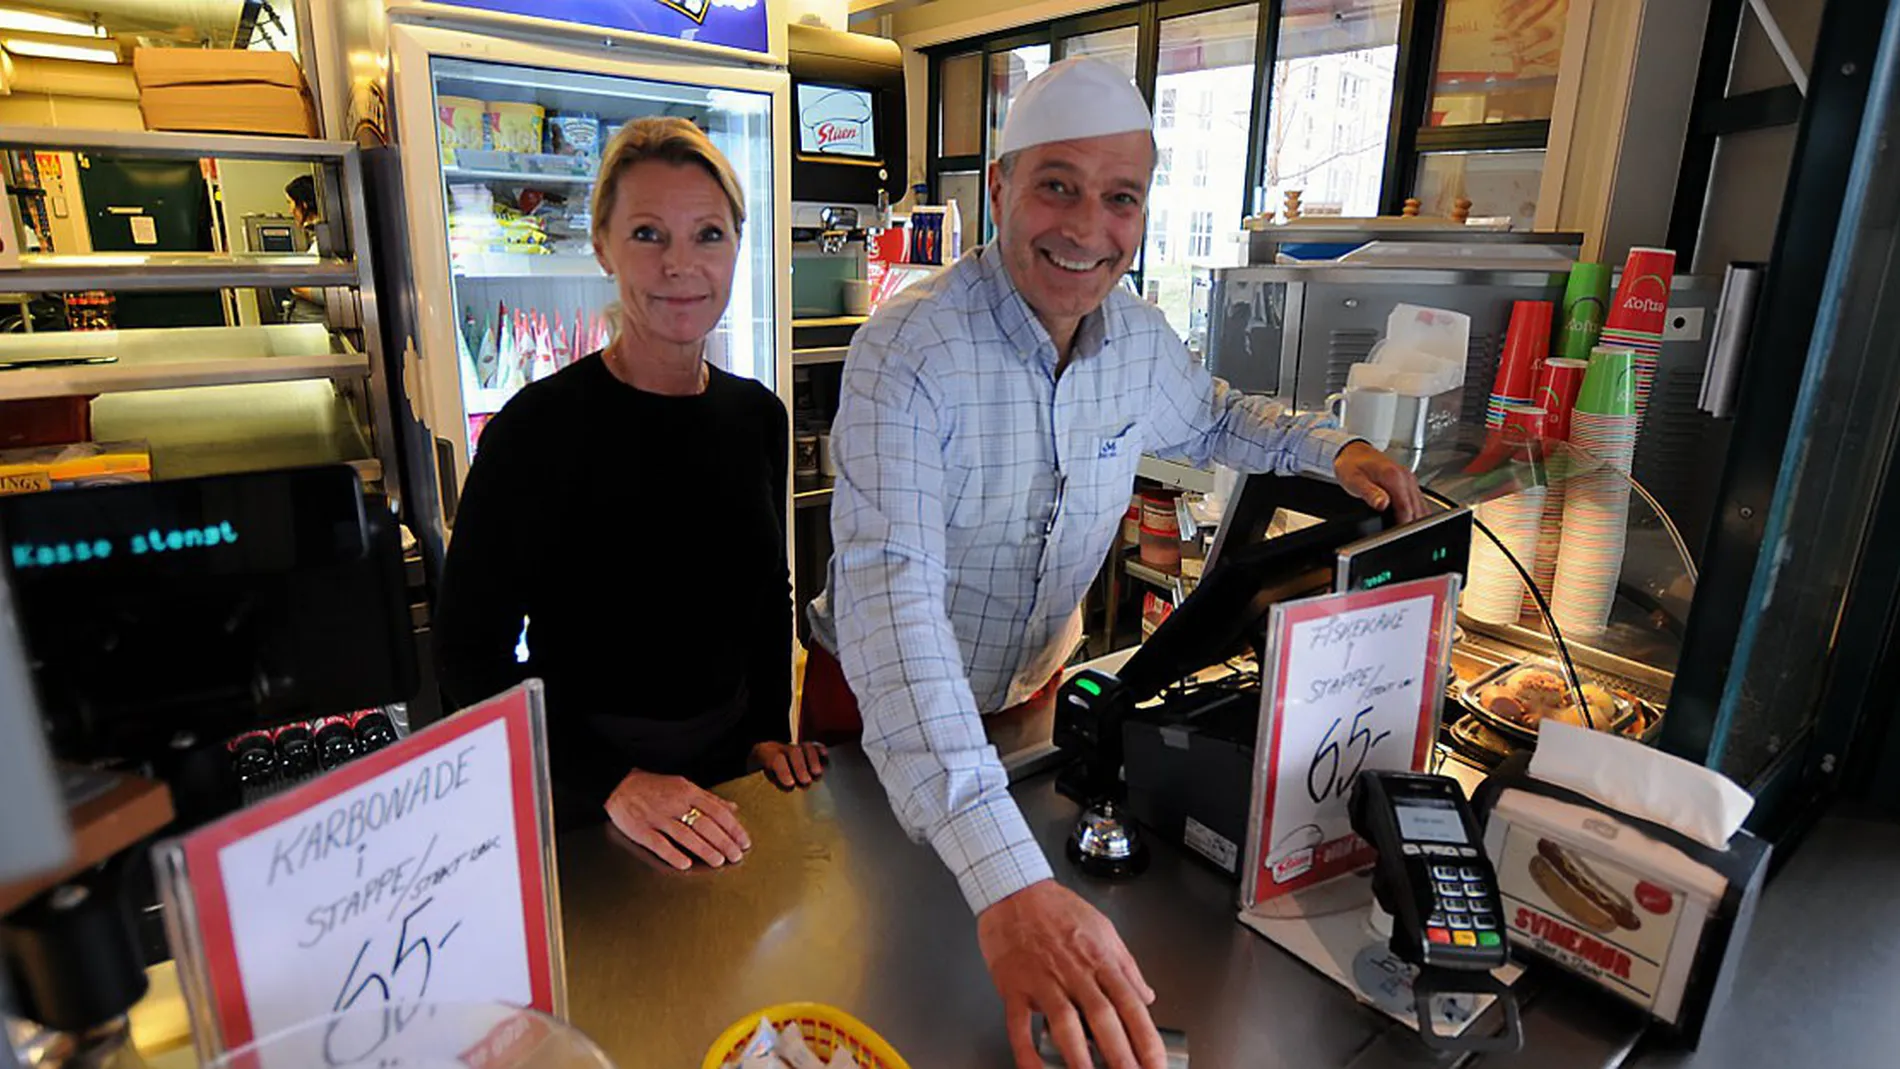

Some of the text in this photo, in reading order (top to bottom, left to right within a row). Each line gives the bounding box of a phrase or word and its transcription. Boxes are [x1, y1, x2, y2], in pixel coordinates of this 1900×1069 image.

[1623, 296, 1665, 312] enjoy
[131, 520, 239, 554] stengt
[267, 745, 476, 887] KARBONADE
